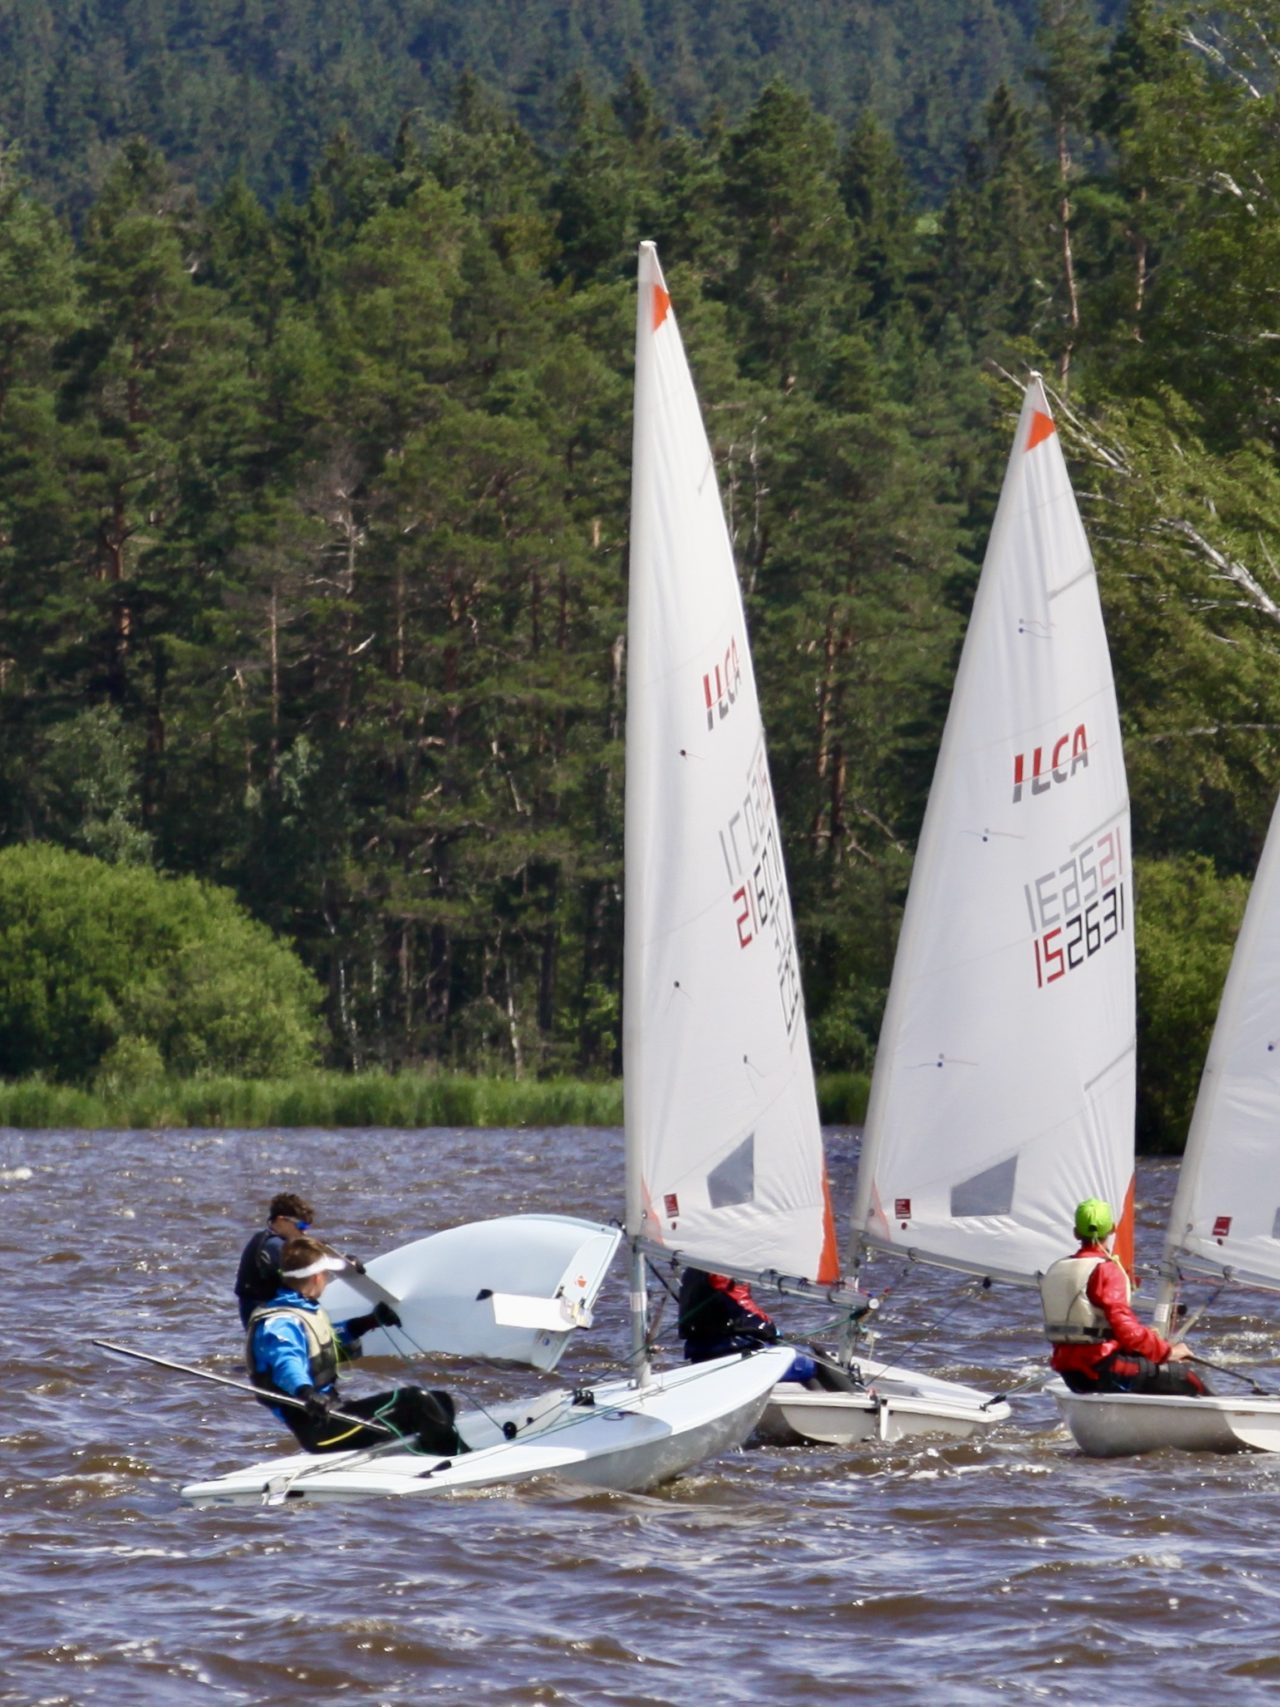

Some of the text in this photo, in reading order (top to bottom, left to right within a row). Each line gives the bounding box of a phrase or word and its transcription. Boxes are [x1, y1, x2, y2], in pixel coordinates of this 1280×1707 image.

[703, 635, 742, 732] ILCA
[1012, 723, 1088, 804] ILCA
[1034, 883, 1124, 988] 152631
